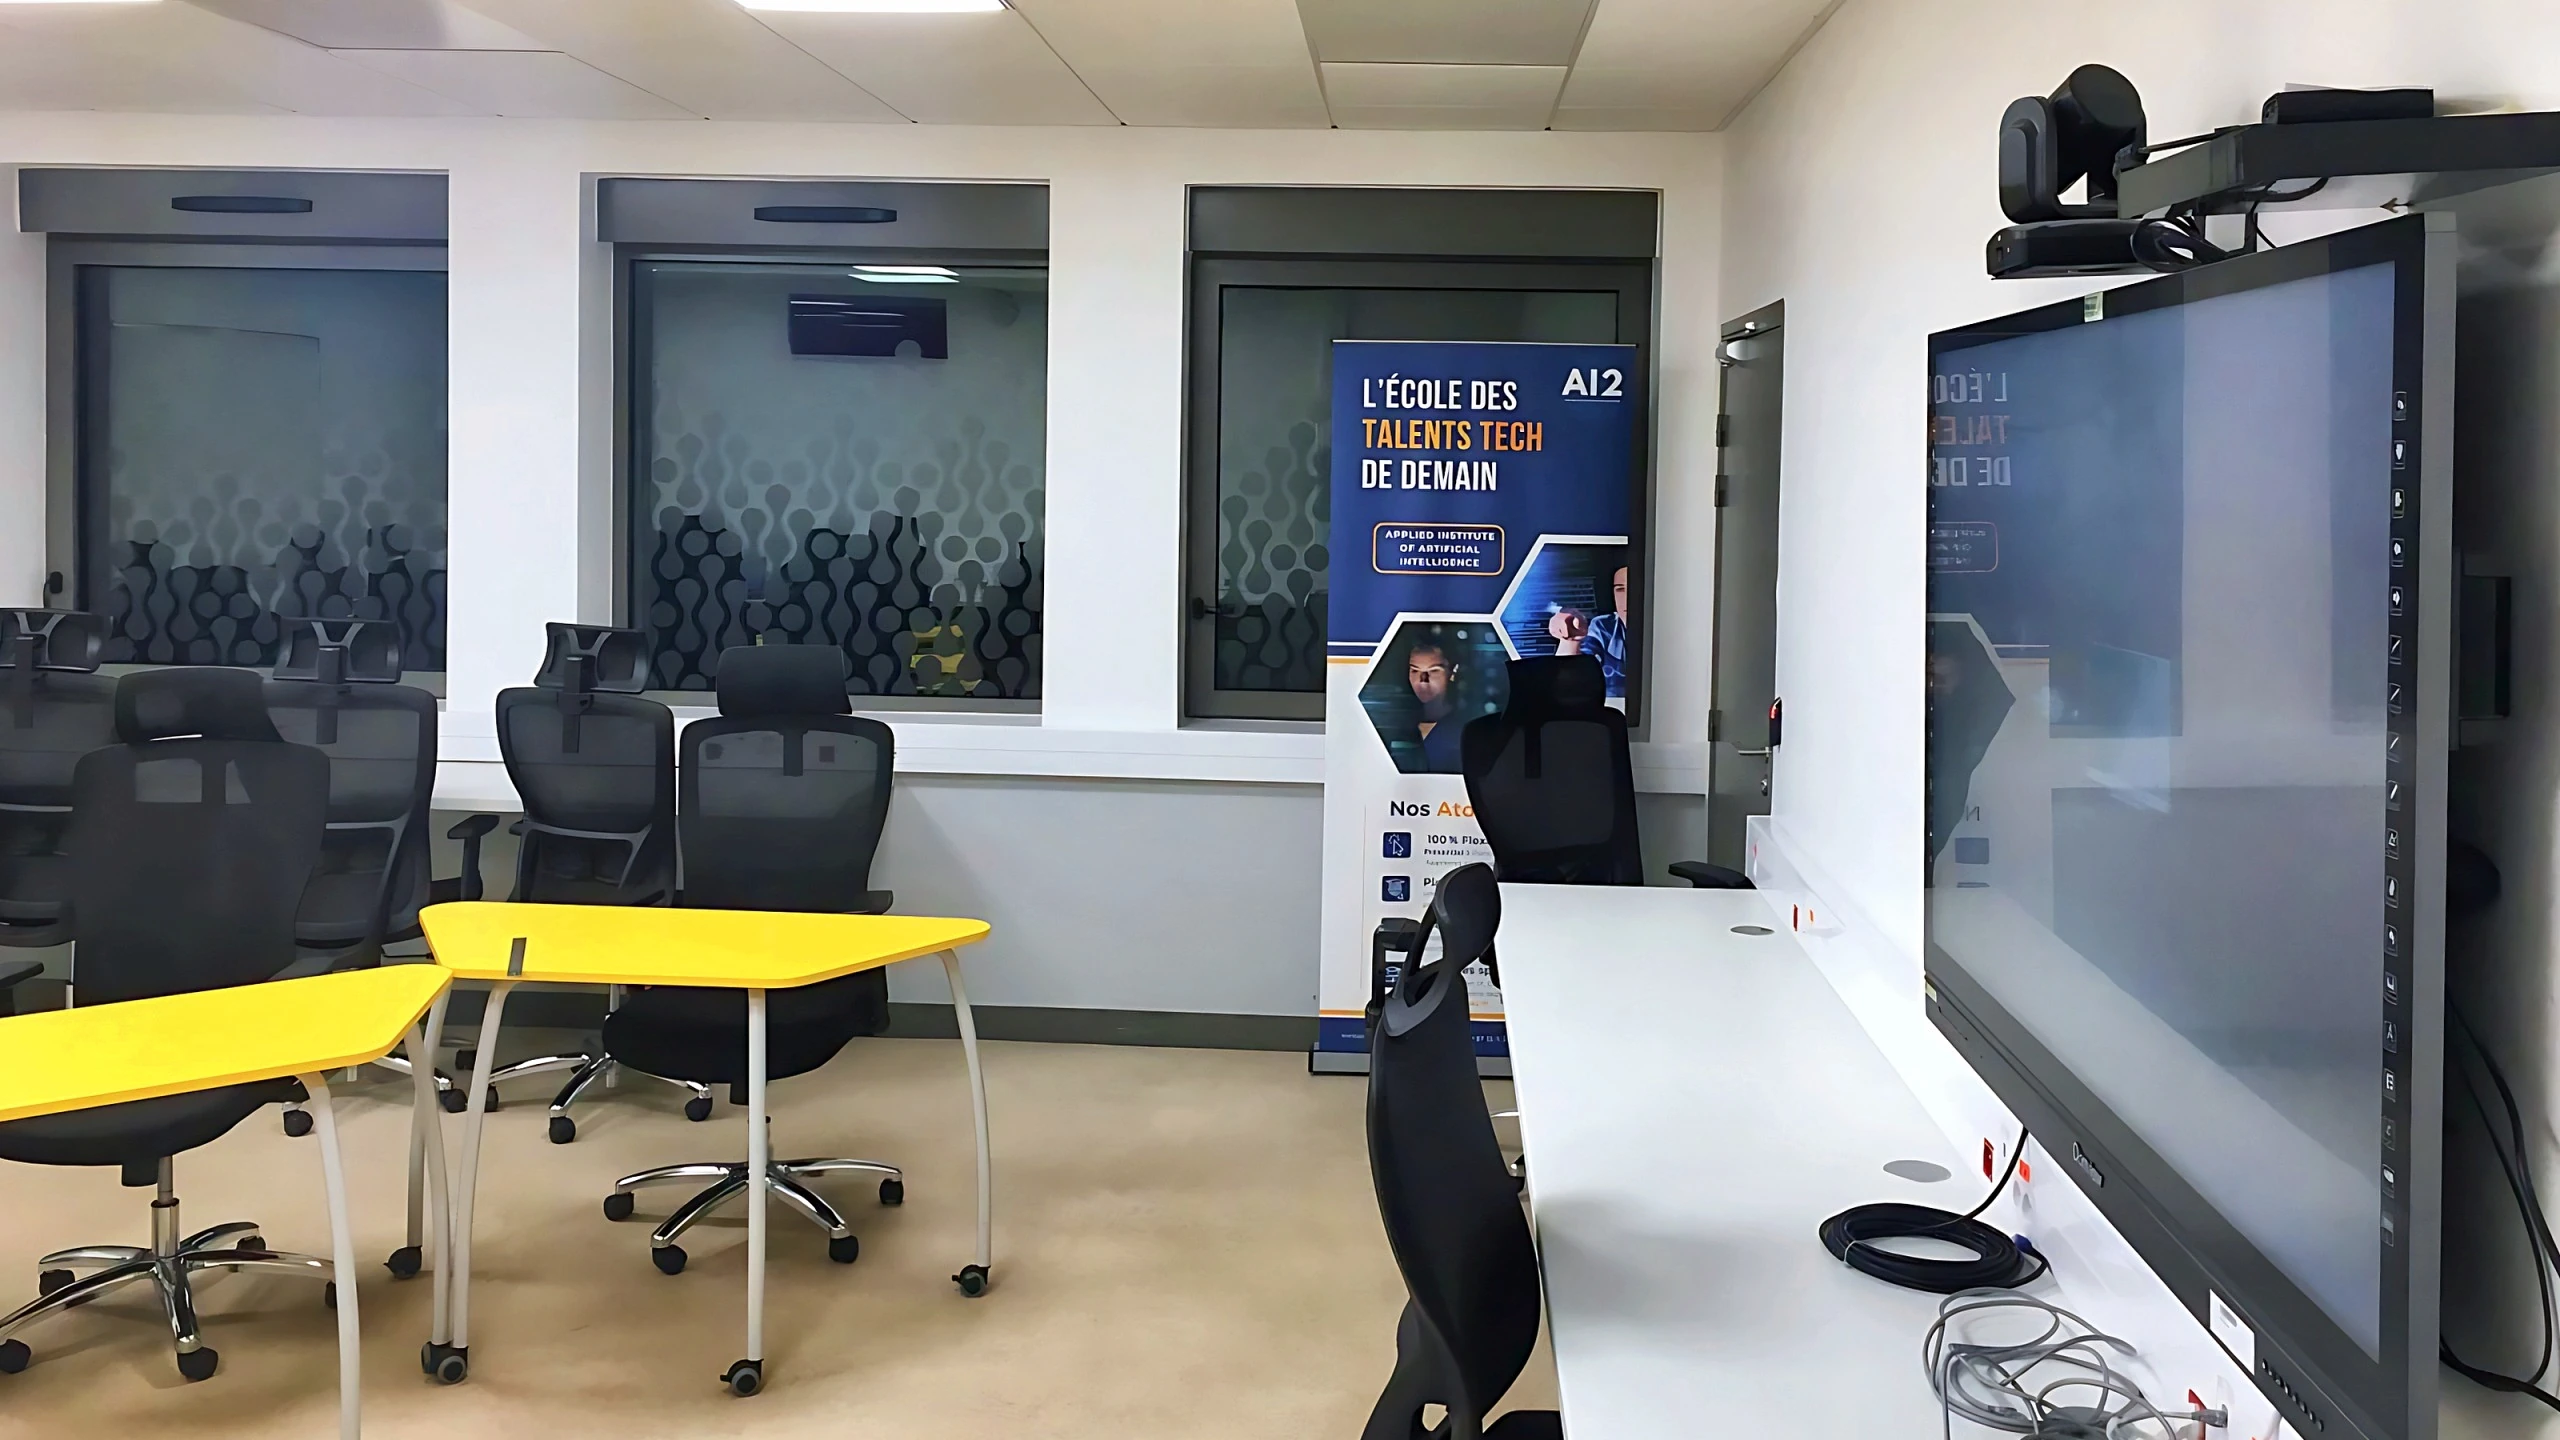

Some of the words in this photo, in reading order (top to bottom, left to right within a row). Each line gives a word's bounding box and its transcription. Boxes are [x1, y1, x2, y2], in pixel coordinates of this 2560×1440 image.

[1561, 368, 1623, 397] AI2
[1363, 373, 1462, 410] L'ÉCOLE
[1471, 380, 1518, 411] DES
[1362, 418, 1471, 450] TALENTS
[1480, 421, 1543, 452] TECH
[1361, 459, 1392, 489] DE
[1401, 460, 1497, 491] DEMAIN
[1385, 529, 1434, 539] APPLIED
[1438, 531, 1495, 541] INSTITUTE
[1400, 544, 1415, 553] OF
[1418, 545, 1480, 554] ARTIFICIAL
[1400, 558, 1480, 567] INTELLIGENCE
[1390, 800, 1431, 817] Nos
[1427, 834, 1447, 844] 100
